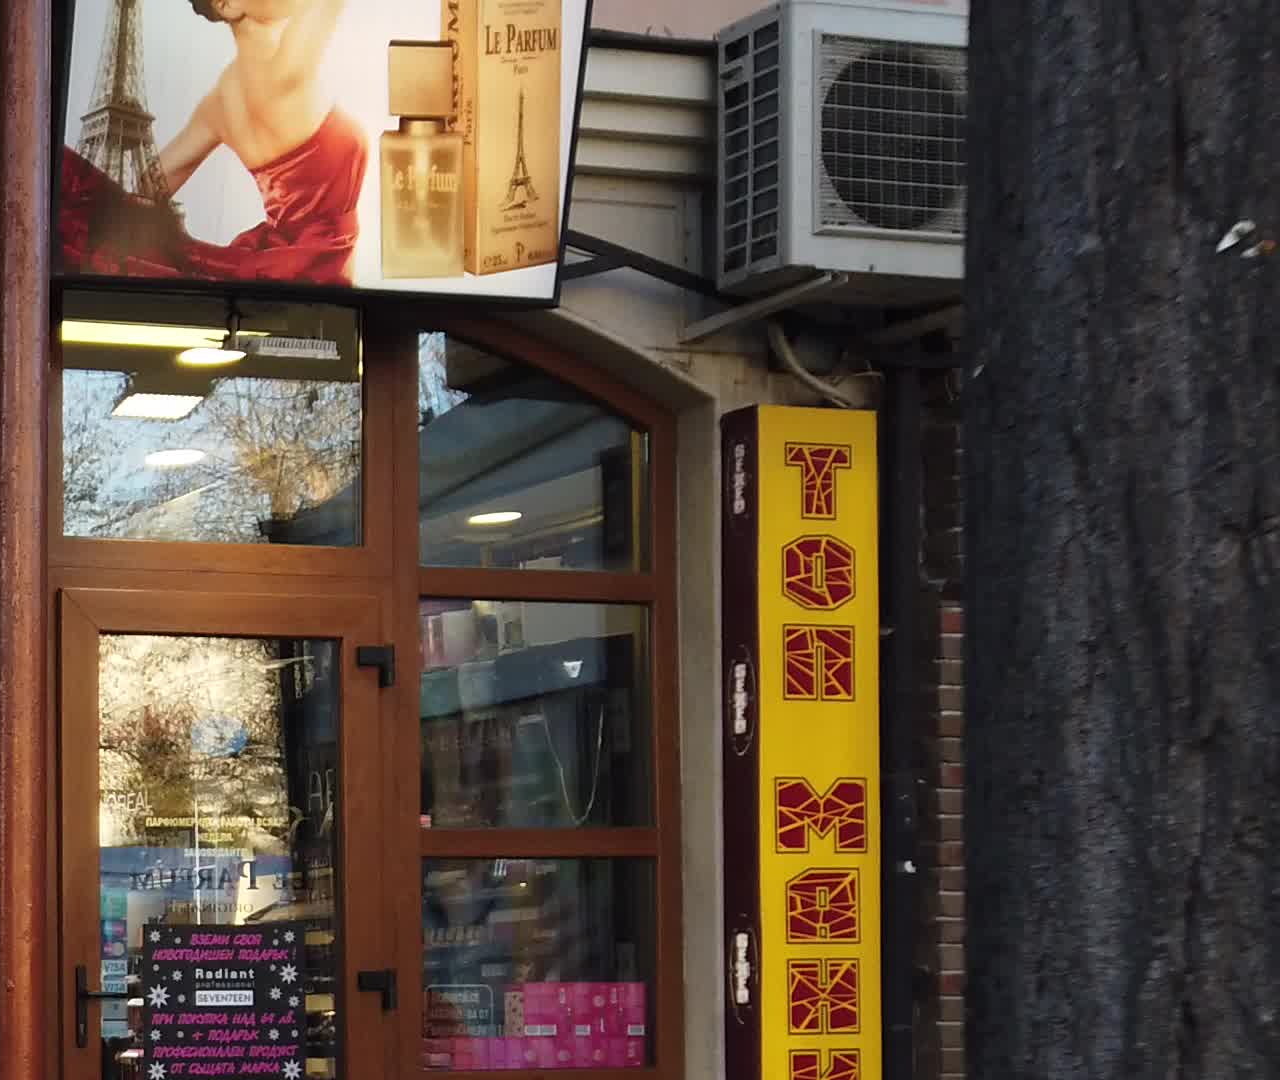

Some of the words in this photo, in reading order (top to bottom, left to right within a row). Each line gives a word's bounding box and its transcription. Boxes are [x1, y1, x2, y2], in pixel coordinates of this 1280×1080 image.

[782, 442, 856, 702] ТОП
[195, 968, 255, 980] Radiant
[151, 1013, 175, 1025] ПРИ
[177, 1013, 228, 1025] ПОКУПКА
[170, 1062, 185, 1074] ОТ
[239, 1062, 280, 1073] МАРКА
